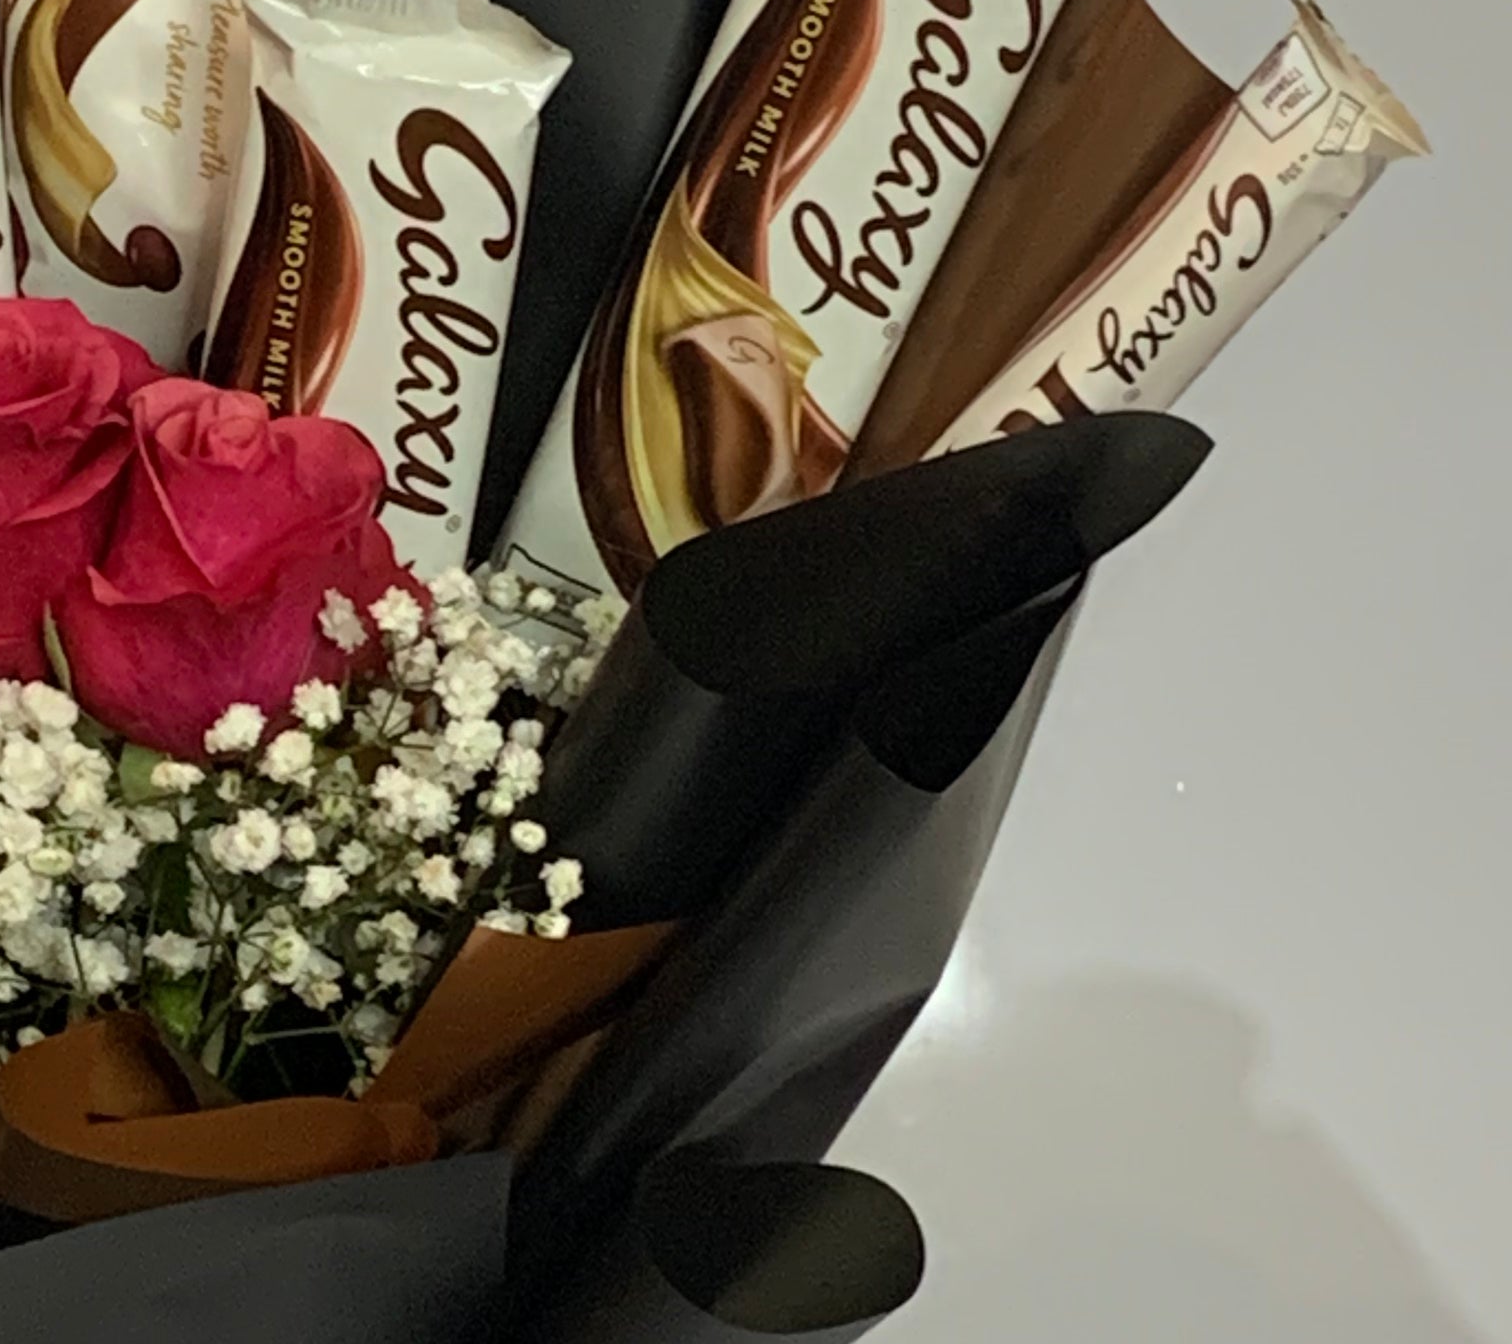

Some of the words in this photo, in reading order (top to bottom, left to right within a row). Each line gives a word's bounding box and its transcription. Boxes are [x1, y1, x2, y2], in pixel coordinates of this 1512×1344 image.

[140, 22, 200, 134] sharing
[197, 104, 229, 181] worth
[735, 103, 786, 178] MILK
[273, 202, 313, 330] SMOOTH
[368, 107, 517, 517] Galaxy
[1086, 173, 1274, 385] Galaxy
[262, 339, 293, 410] MILK
